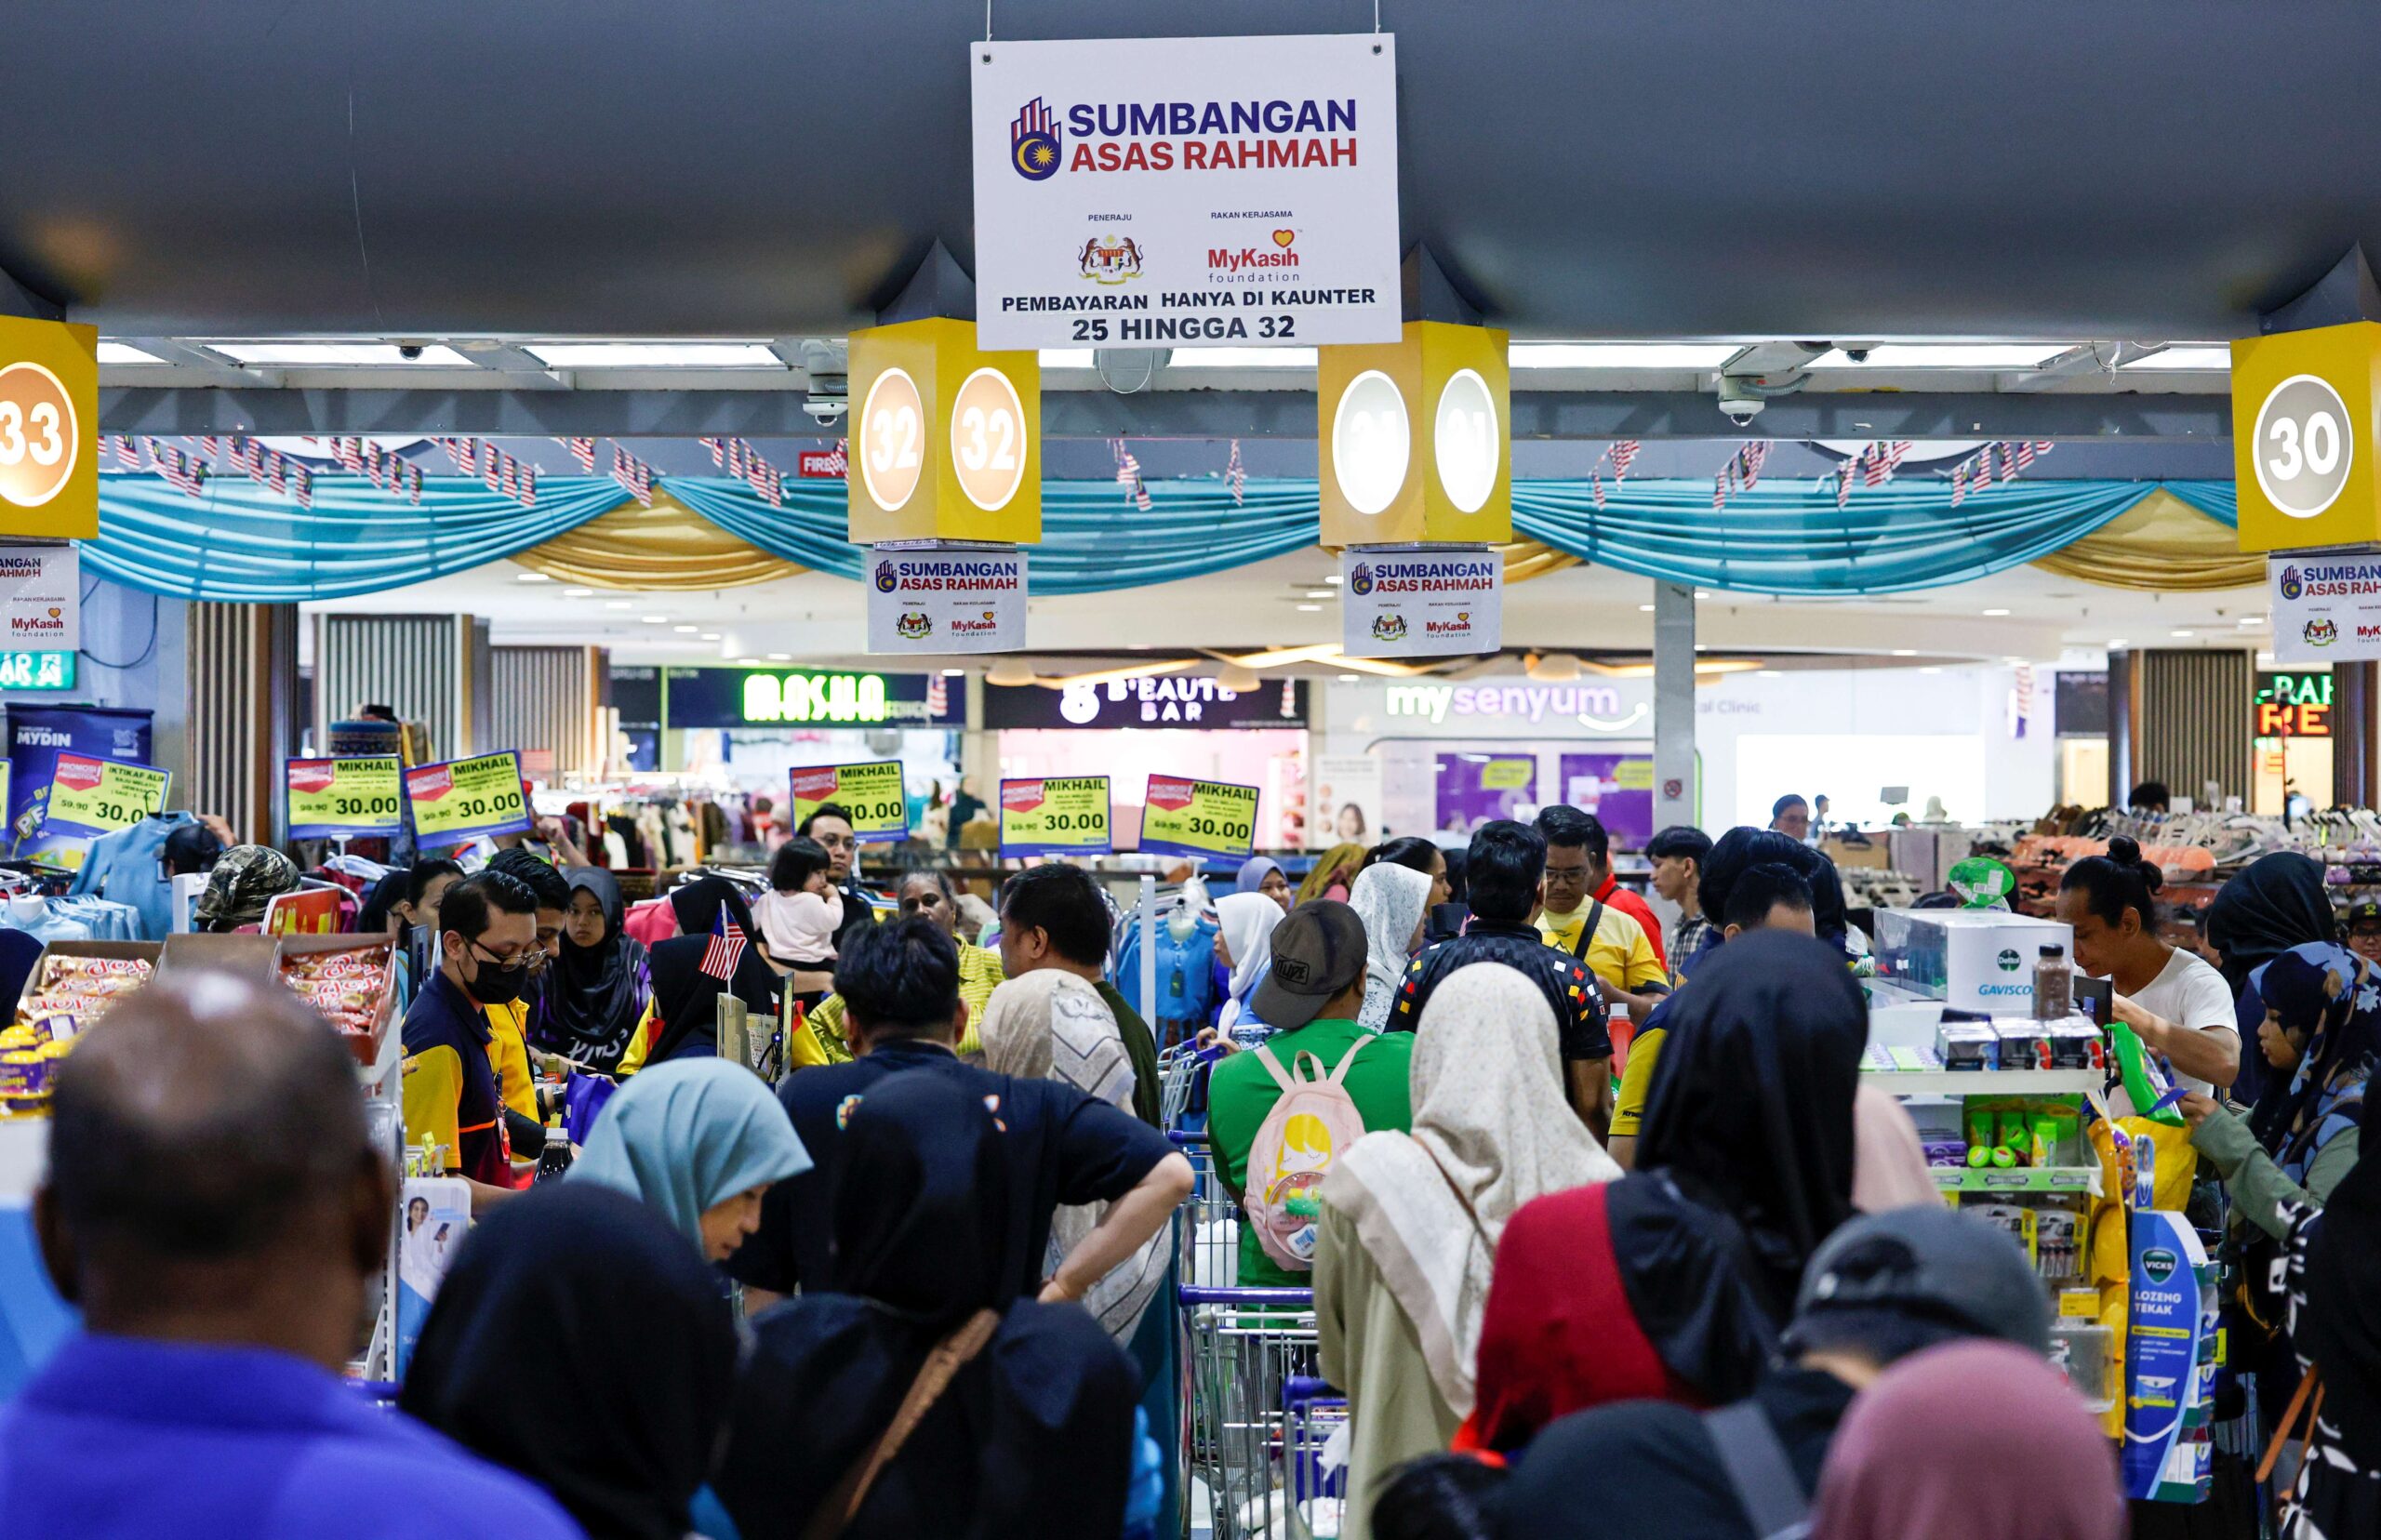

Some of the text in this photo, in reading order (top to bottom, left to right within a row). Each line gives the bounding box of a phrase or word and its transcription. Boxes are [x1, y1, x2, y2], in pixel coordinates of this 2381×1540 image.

[1069, 99, 1356, 137] SUMBANGAN
[1070, 139, 1358, 172] ASAS RAHMAH
[1088, 213, 1132, 221] PENERAJU
[1211, 210, 1293, 219] RAKAN KERJASAMA
[1208, 247, 1299, 272] MyKasih
[1209, 272, 1299, 283] foundation
[1002, 288, 1376, 312] PEMBAYARAN HANYA DI KAUNTER
[1072, 315, 1296, 341] 25 HINGGA 32
[0, 401, 62, 466] 33
[871, 406, 918, 472] 32
[961, 406, 1015, 471] 32
[2268, 411, 2340, 480] 30
[899, 563, 1018, 576] SUMBANGAN
[1376, 563, 1493, 578] SUMBANGAN
[2304, 565, 2381, 581] SUMBAN
[899, 578, 1018, 591] ASAS RAHMAH
[1376, 578, 1493, 592] ASAS RAHMAH
[2305, 583, 2348, 596] ASAS
[12, 617, 63, 631] MyKasih
[951, 620, 996, 631] MyKasih
[1427, 621, 1470, 633] MyKasih
[1140, 701, 1203, 722] BAR
[1717, 699, 1761, 714] Clinic
[17, 732, 72, 747] MYDIN
[109, 766, 144, 779] IKTIKAF
[338, 761, 396, 772] MIKHAIL
[454, 756, 512, 776] MIKHAIL
[841, 765, 898, 778] MIKHAIL
[1044, 779, 1106, 791] MIKHAIL
[1192, 783, 1257, 801] MIKHAIL
[61, 799, 88, 811] 59.90
[336, 798, 398, 815] 30.00
[458, 792, 521, 817] 30.00
[1044, 814, 1104, 830] 30.00
[1189, 817, 1249, 839] 30.00
[1978, 984, 2033, 995] GAVISCO
[2146, 1261, 2173, 1270] VICKS
[2135, 1291, 2182, 1304] LOZENG
[2135, 1303, 2173, 1315] TEKAK
